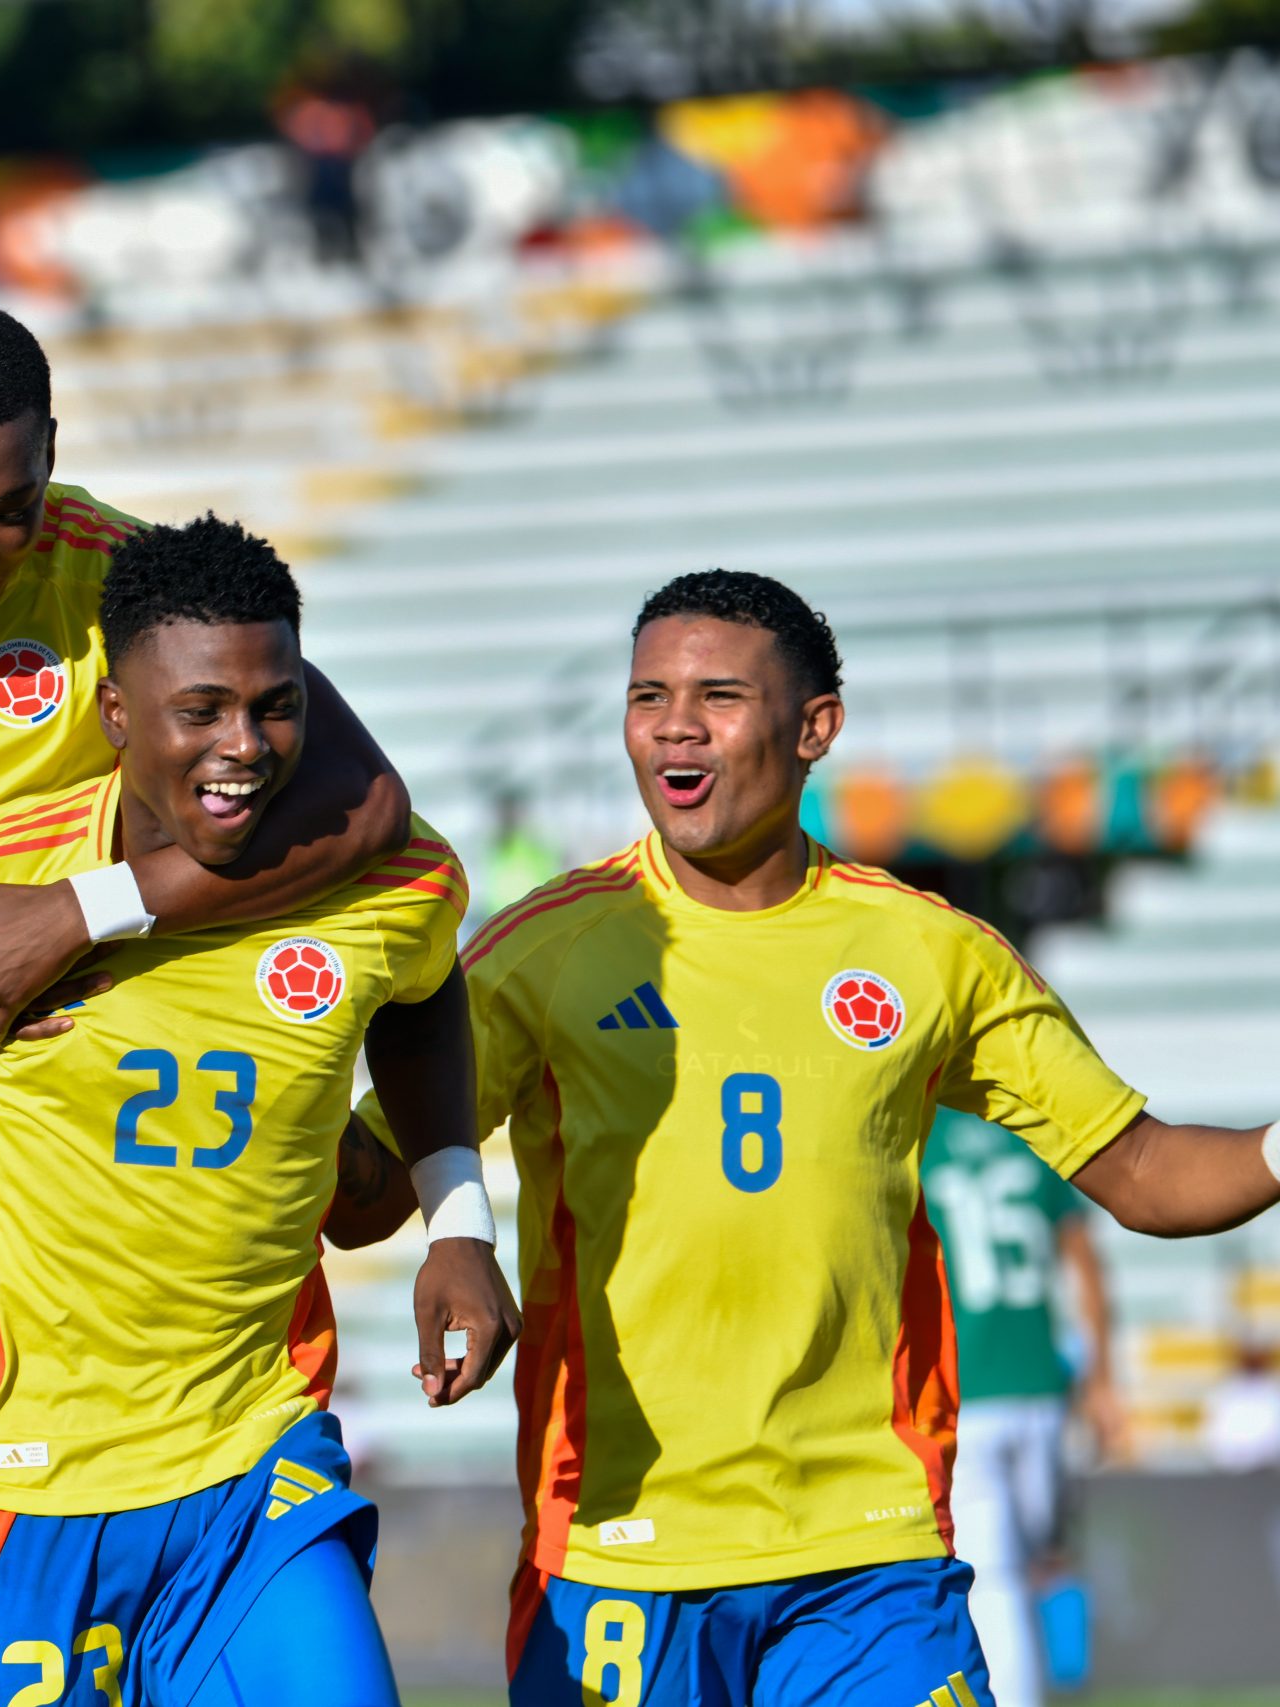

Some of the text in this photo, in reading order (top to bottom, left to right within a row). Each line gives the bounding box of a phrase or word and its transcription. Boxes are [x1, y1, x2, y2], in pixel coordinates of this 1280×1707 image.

[280, 938, 321, 948] COLOMBIANA
[114, 1048, 257, 1170] 23
[656, 1052, 841, 1079] CATAPULT
[721, 1072, 782, 1193] 8
[927, 1157, 1050, 1313] 15
[1, 1623, 124, 1707] 23
[581, 1599, 646, 1707] 8
